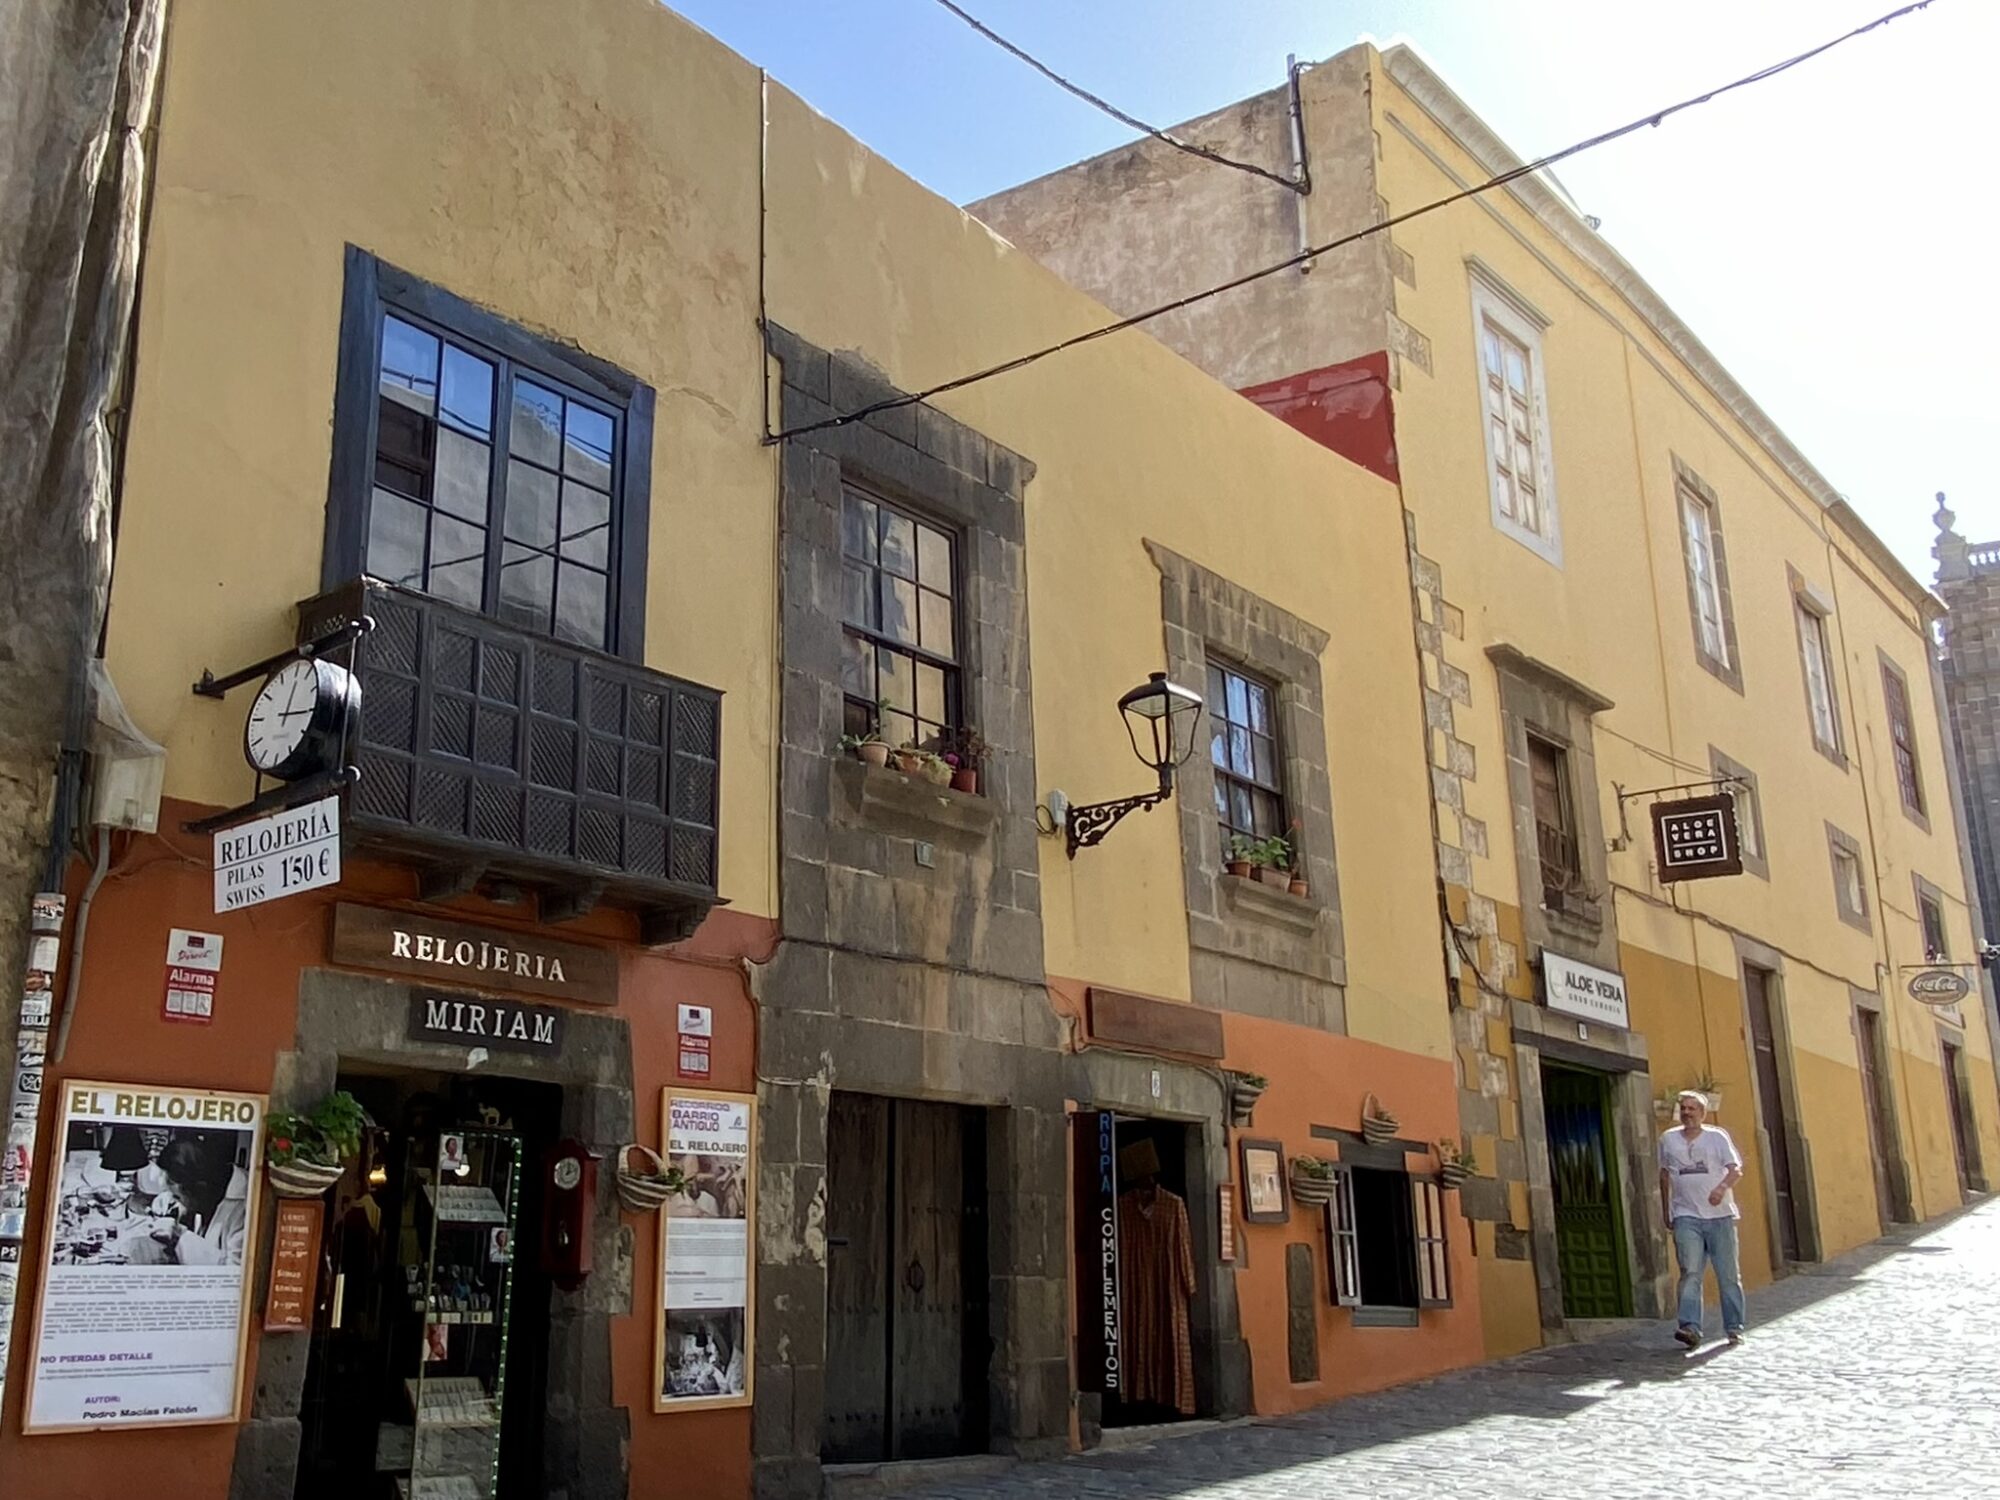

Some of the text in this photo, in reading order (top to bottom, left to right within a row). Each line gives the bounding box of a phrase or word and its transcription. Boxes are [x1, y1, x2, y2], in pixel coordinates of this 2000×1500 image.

[1671, 818, 1714, 832] ALOE
[221, 807, 331, 864] RELOJERÍA
[1671, 829, 1716, 841] VERA
[1673, 845, 1717, 858] SHOP
[226, 861, 265, 886] PILAS
[319, 847, 330, 876] €
[226, 883, 265, 909] SWISS
[391, 931, 566, 983] RELOJERIA
[169, 968, 215, 986] Alarma
[1565, 970, 1623, 1003] ALOE VERA
[425, 1000, 555, 1043] MIRIAM
[71, 1091, 255, 1124] EL RELOJERO
[671, 1100, 730, 1112] RECORRIDO
[672, 1109, 719, 1122] BARRIO
[673, 1119, 720, 1132] ANTIGUO
[670, 1140, 747, 1153] EL RELOJERO
[1100, 1113, 1111, 1192] ROPA
[1102, 1208, 1118, 1388] COMPLEMENTOS
[40, 1352, 153, 1364] NO PIERDAS DETALLE
[84, 1396, 121, 1405] AUTOR:
[82, 1405, 198, 1420] Pedro Macías Falcón
